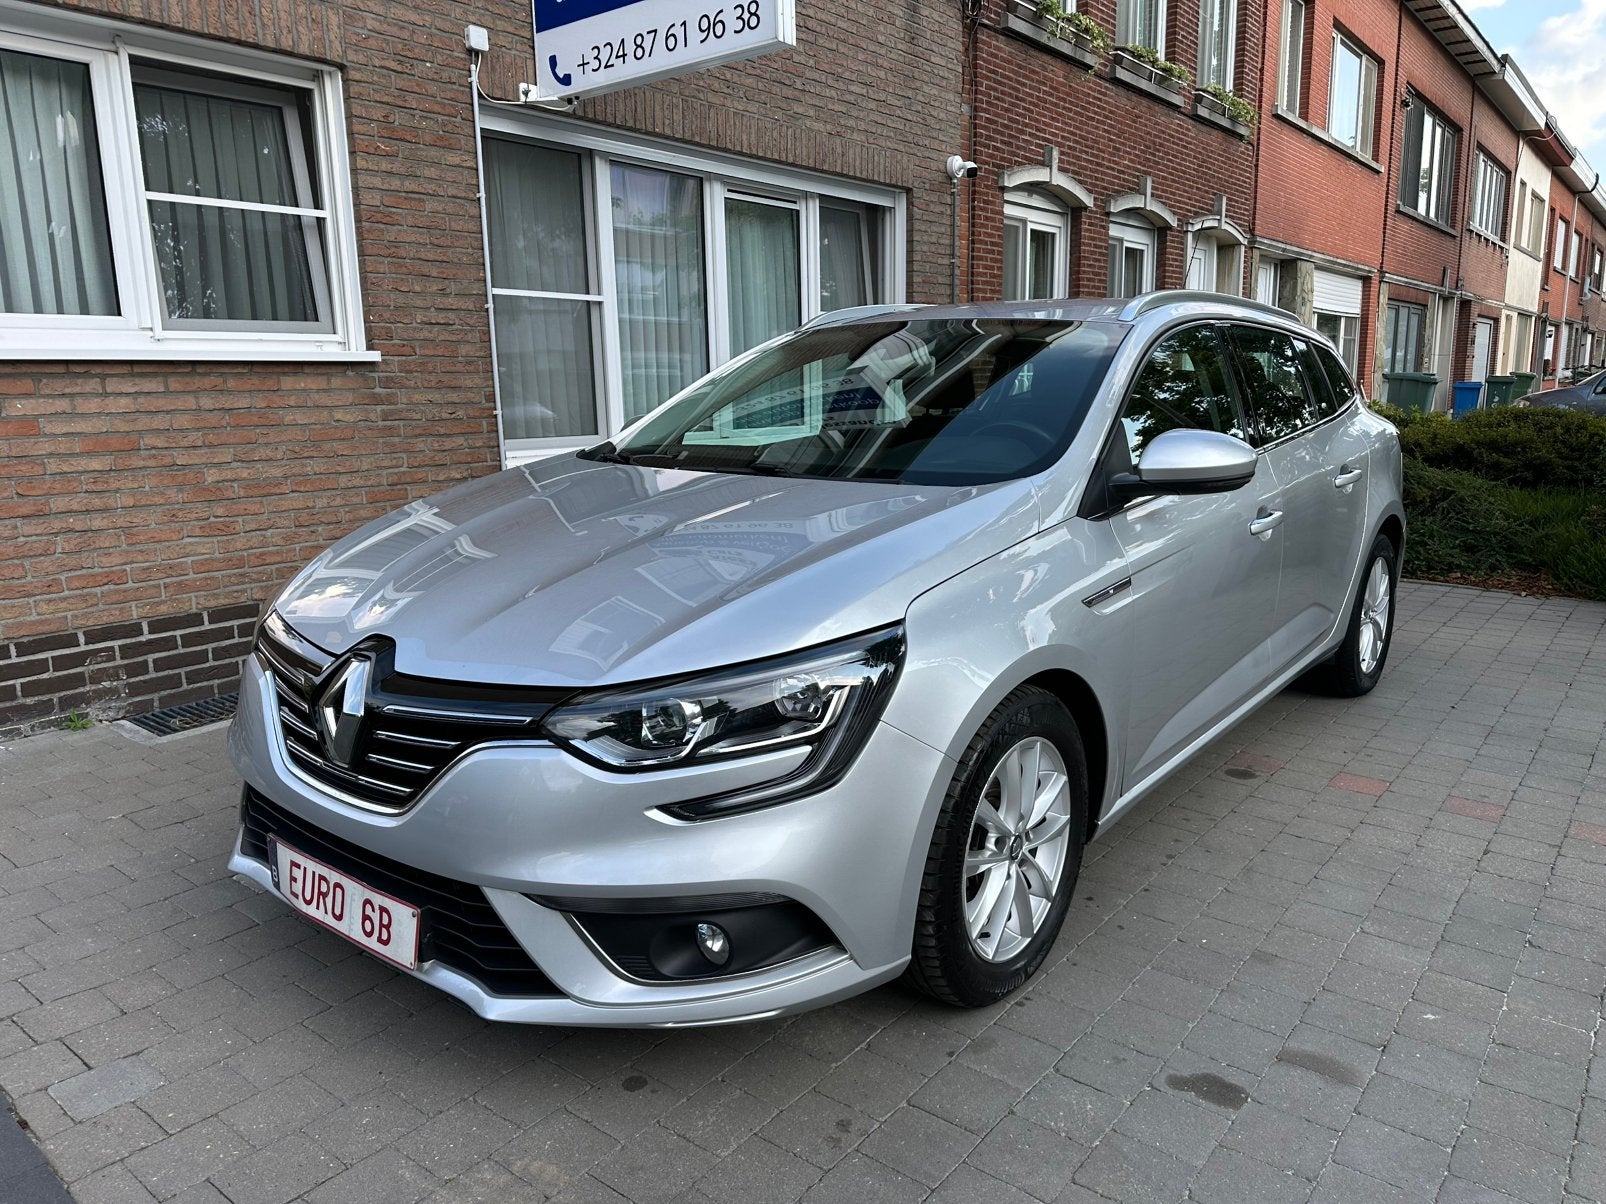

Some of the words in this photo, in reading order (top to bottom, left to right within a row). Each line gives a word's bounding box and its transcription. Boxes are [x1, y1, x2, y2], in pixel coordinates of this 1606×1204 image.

[577, 37, 628, 75] +324
[633, 28, 658, 61] 87
[665, 20, 688, 52] 61
[698, 8, 726, 44] 96
[733, 0, 761, 34] 38
[271, 865, 279, 883] B
[289, 859, 345, 922] EURO
[361, 897, 393, 947] 6B
